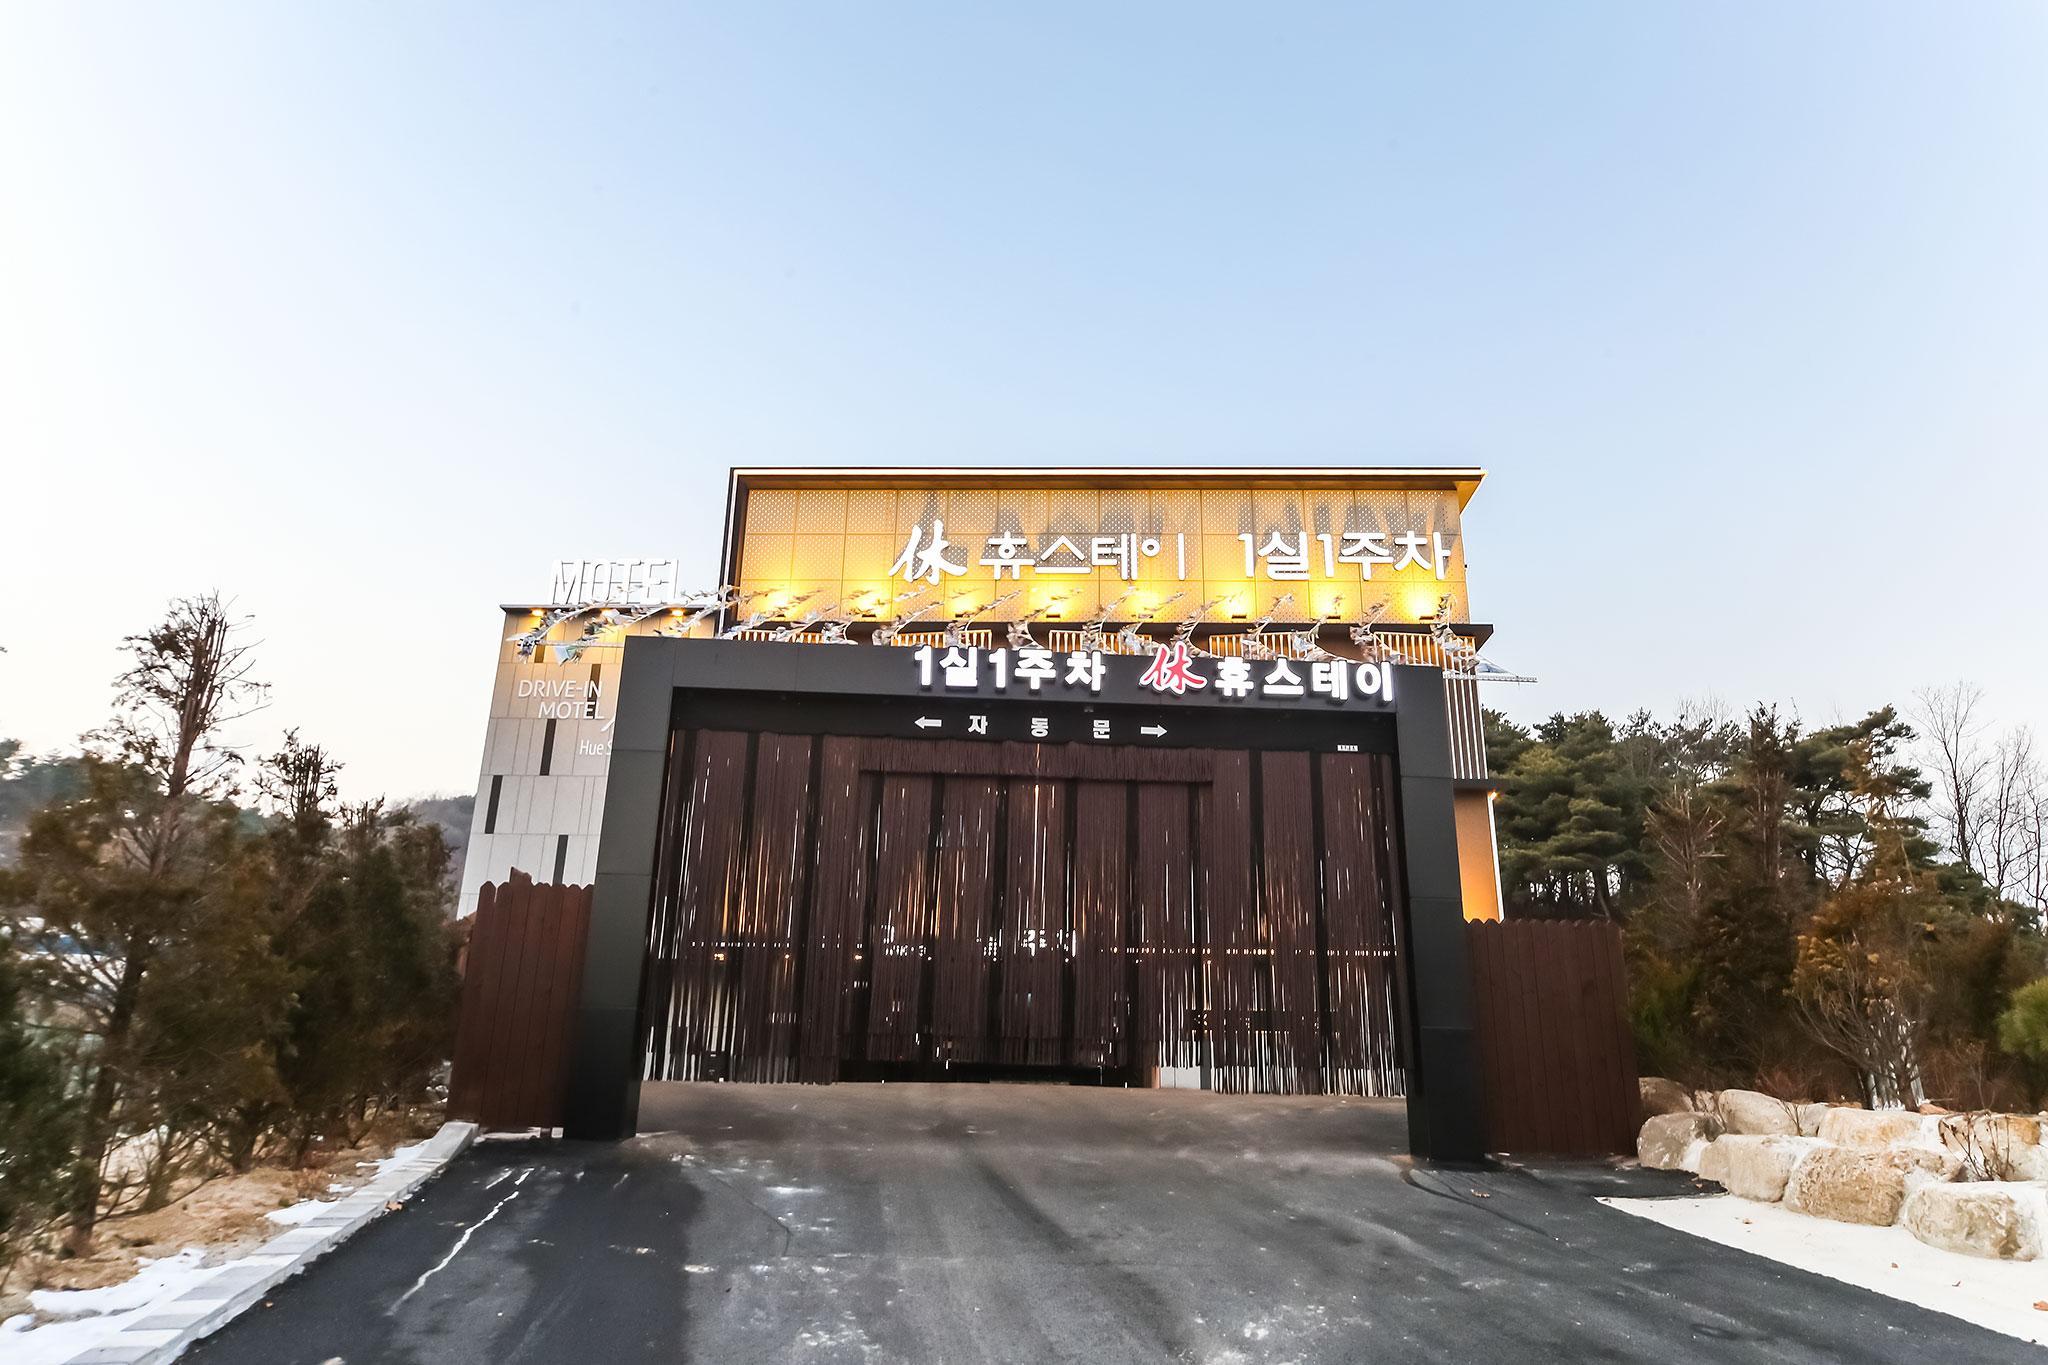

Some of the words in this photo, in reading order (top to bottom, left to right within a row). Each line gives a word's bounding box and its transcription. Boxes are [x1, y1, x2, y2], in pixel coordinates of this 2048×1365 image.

[888, 519, 968, 586] 休
[979, 530, 1186, 581] 휴스테이
[551, 558, 688, 605] MOTEL
[1139, 641, 1208, 695] 休
[1215, 656, 1393, 702] 휴스테이
[518, 680, 604, 698] DRIVE-IN
[538, 701, 605, 719] MOTEL
[579, 739, 604, 756] Hue
